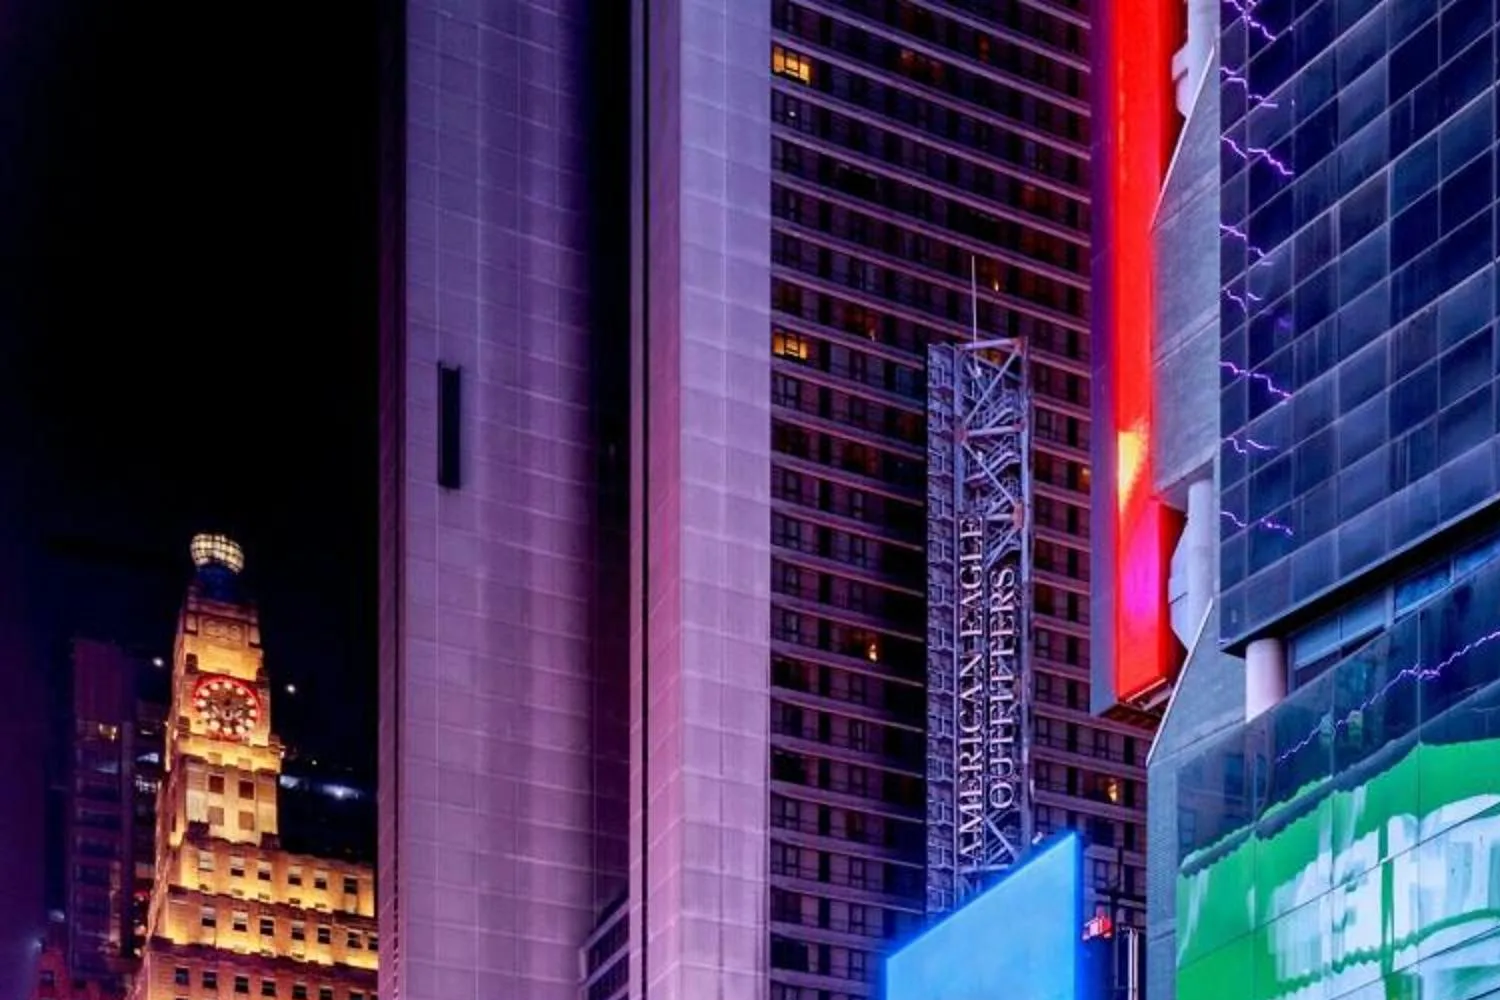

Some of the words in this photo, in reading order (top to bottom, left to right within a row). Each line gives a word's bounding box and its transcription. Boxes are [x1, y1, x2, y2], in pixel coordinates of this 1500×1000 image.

[959, 515, 984, 638] EAGLE
[959, 652, 984, 862] AMERICAN
[989, 566, 1016, 810] OUTFITTERS
